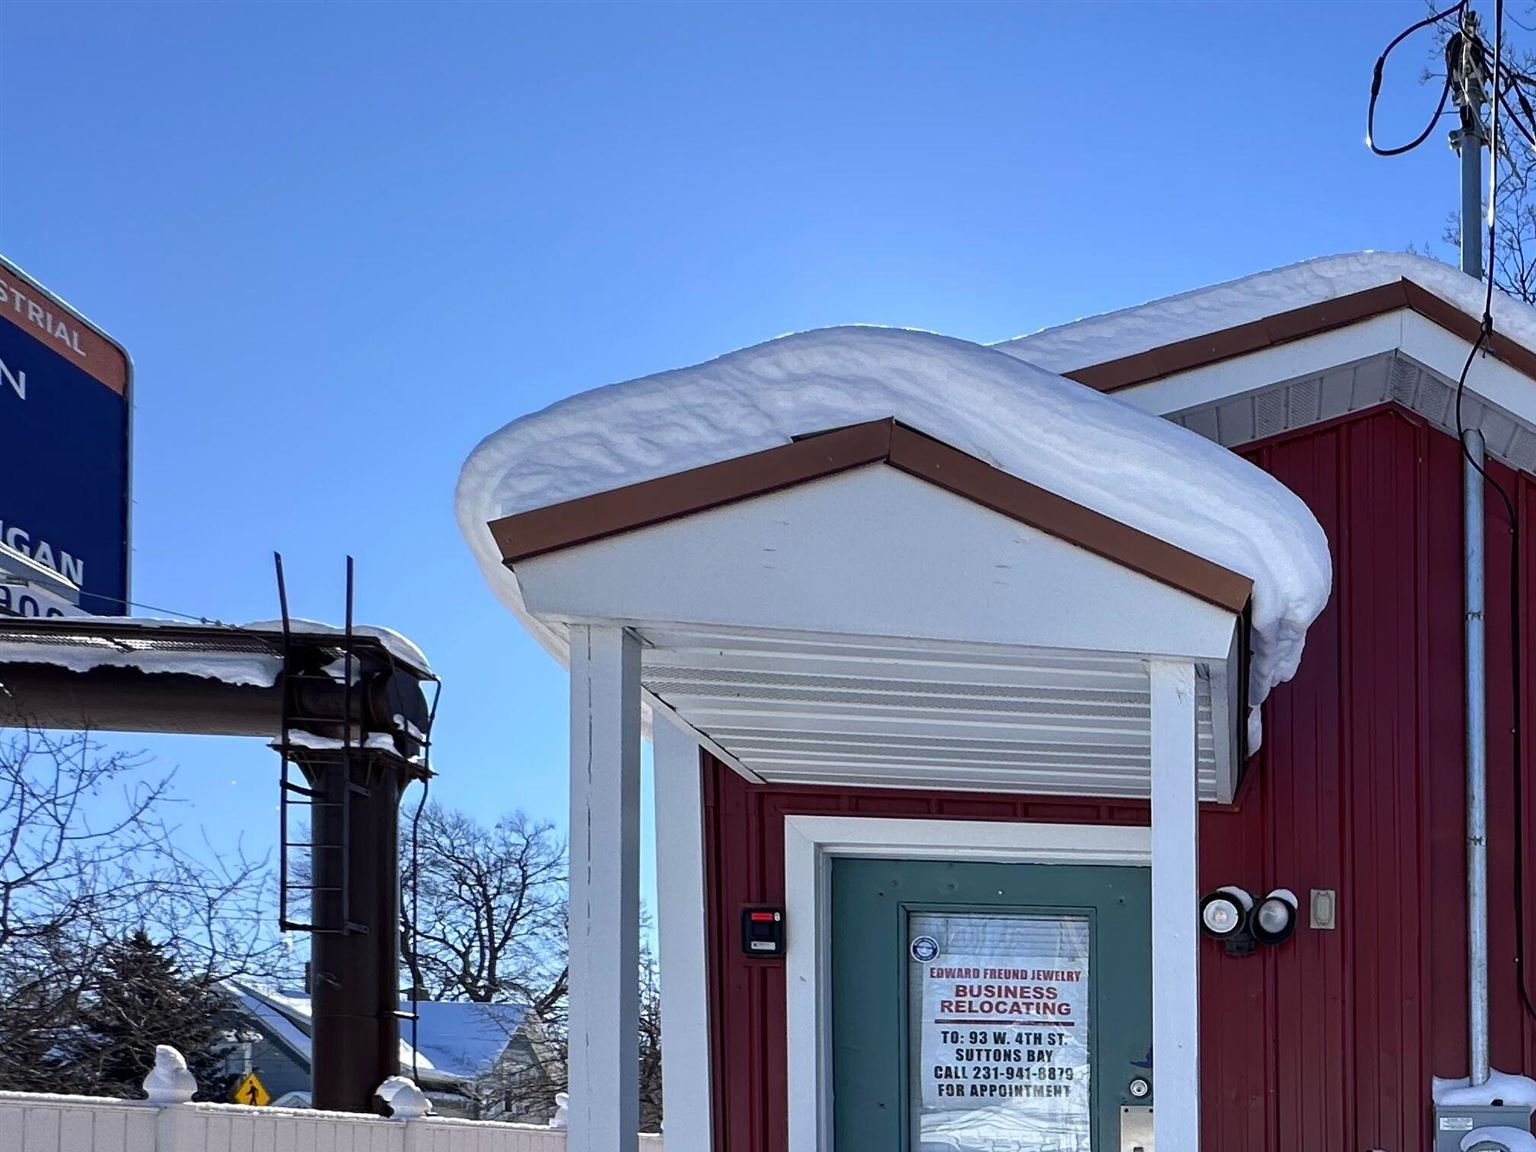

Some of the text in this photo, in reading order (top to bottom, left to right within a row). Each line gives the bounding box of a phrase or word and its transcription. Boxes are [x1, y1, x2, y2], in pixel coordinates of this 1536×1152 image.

[929, 967, 1082, 982] EDWARD FREUND JEWELRY
[955, 984, 1058, 999] BUSINESS
[940, 1000, 1072, 1016] RELOCATING
[941, 1031, 1068, 1046] TO: 93 W. 4TH ST.
[955, 1048, 1054, 1063] SUTTONS BAY
[934, 1065, 1074, 1081] CALL 231-941-8879
[938, 1084, 1071, 1098] FOR APPOINTMENT
